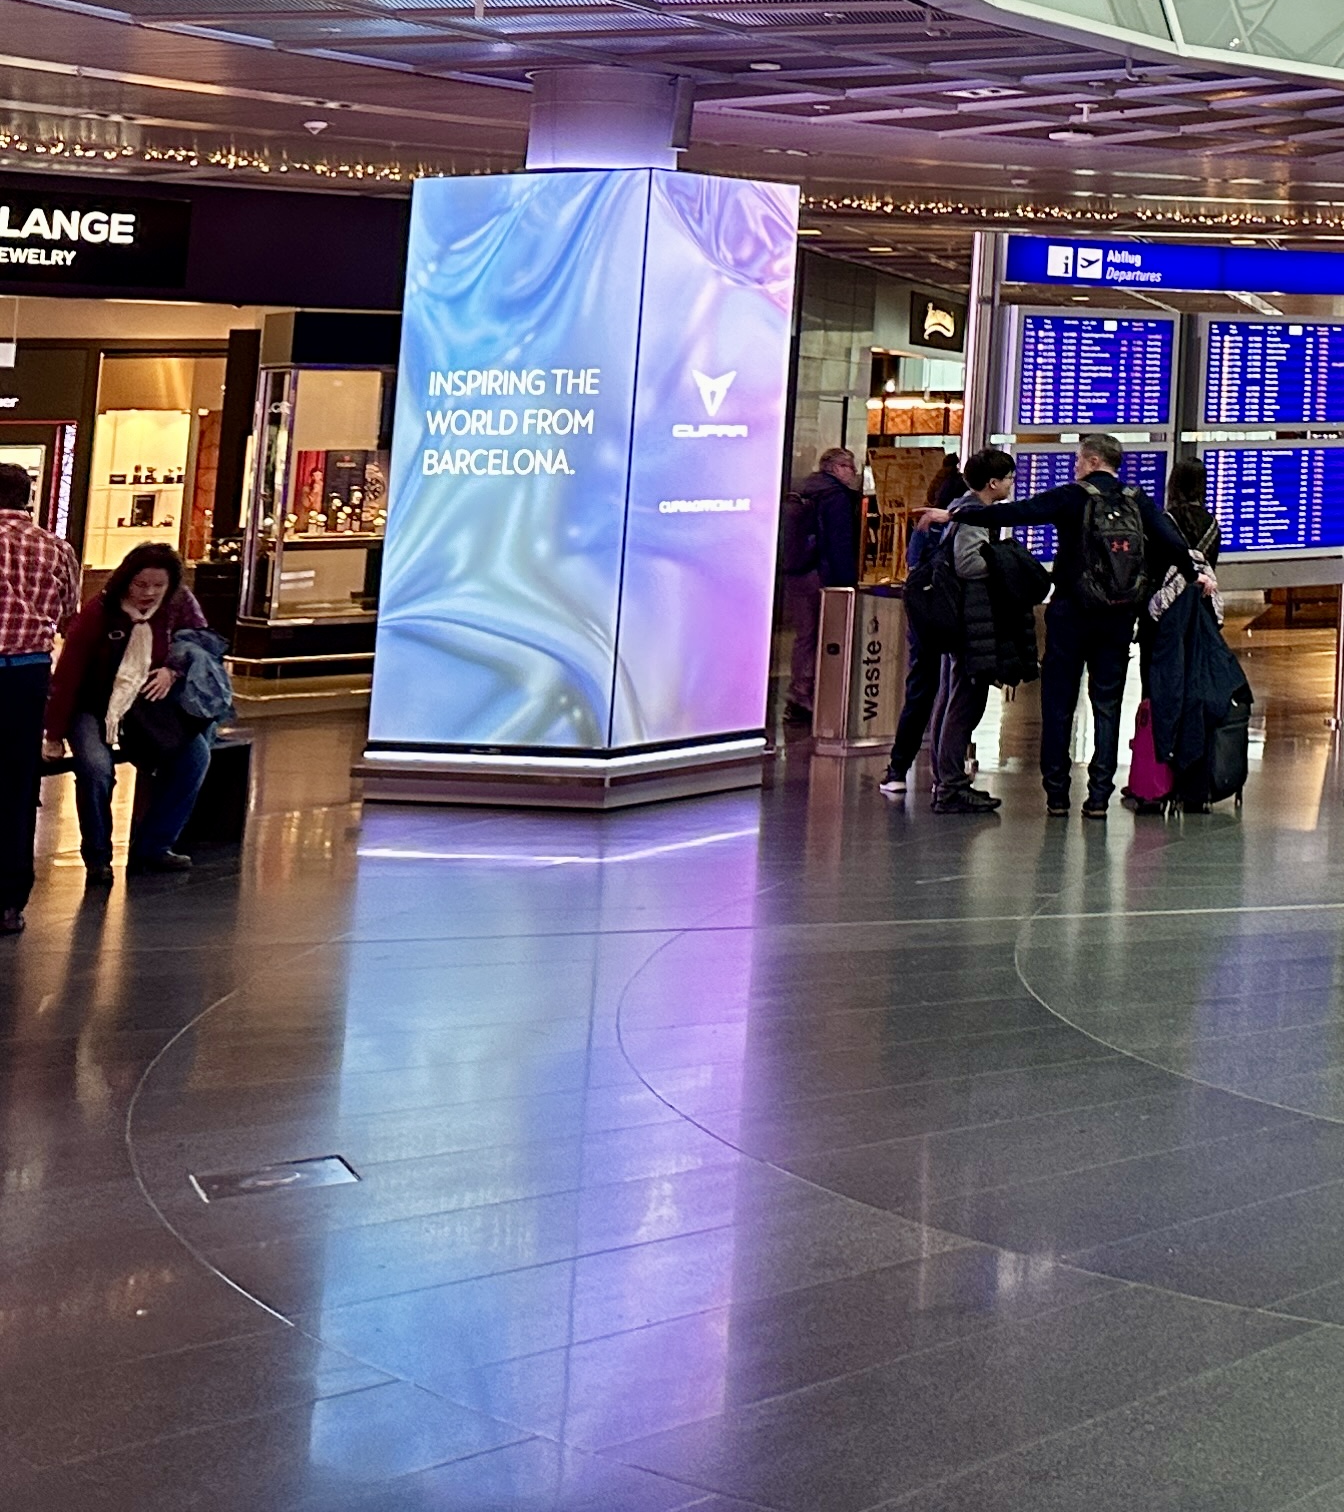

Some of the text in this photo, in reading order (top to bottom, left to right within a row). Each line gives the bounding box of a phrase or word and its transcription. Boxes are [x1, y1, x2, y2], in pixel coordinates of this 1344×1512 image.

[0, 205, 136, 245] LANGE
[1106, 249, 1142, 267] Abflug
[1105, 266, 1163, 283] Departures
[428, 368, 601, 397] INSPIRING THE
[426, 408, 595, 437] WORLD FROM
[422, 448, 576, 476] BARCELONA.
[862, 639, 883, 722] waste
